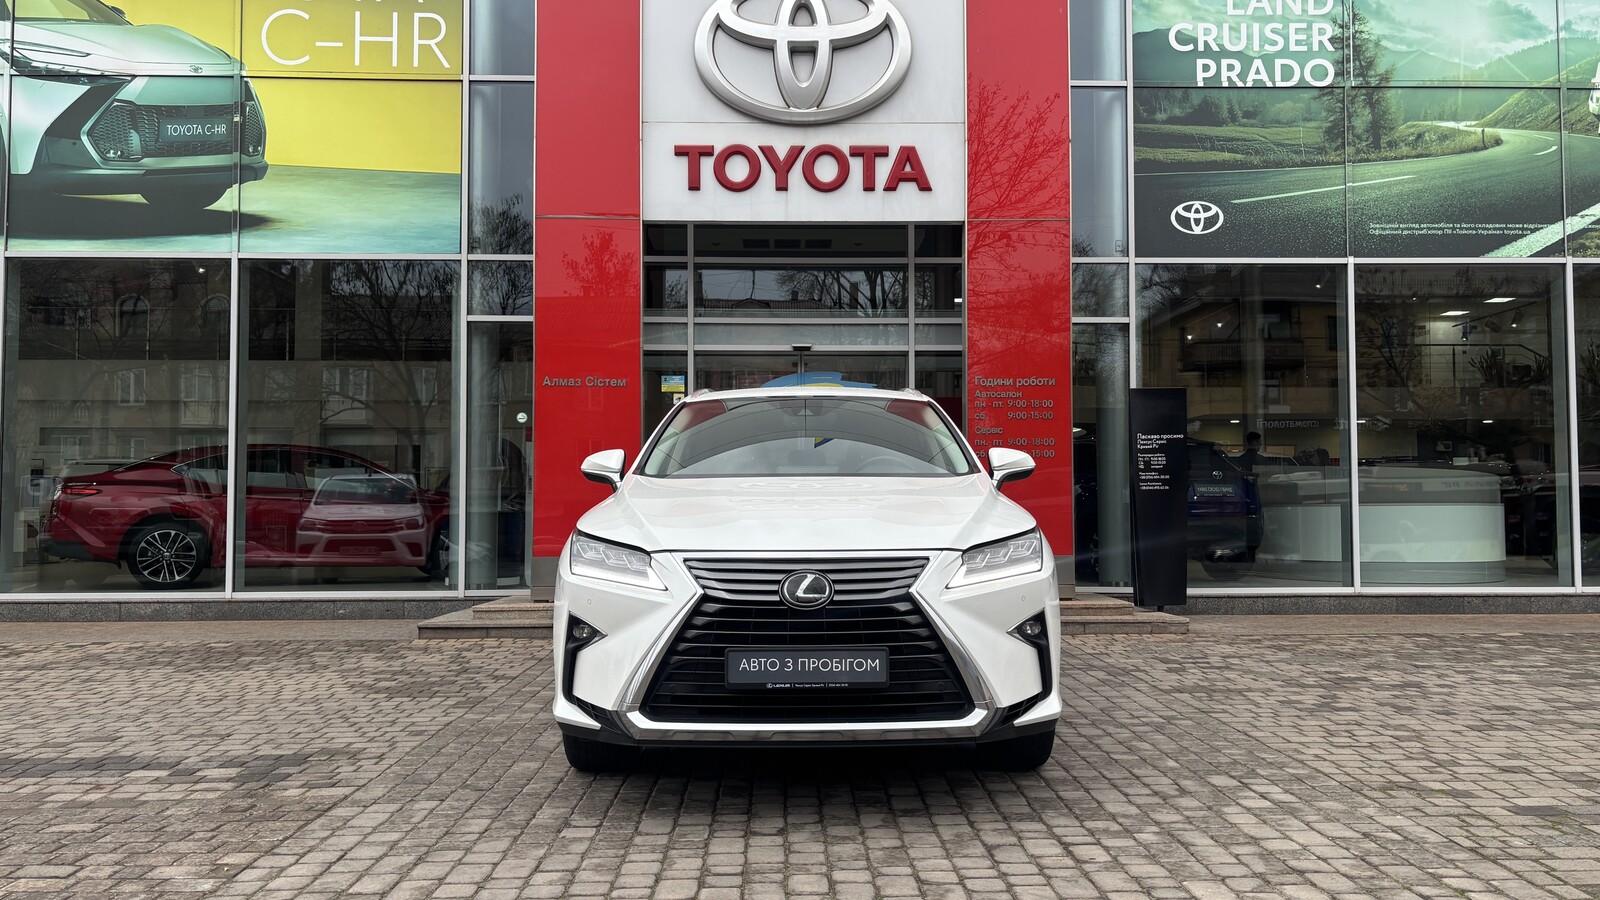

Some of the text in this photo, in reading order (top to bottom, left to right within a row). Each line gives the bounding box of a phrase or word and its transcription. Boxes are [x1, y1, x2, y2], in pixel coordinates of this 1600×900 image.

[261, 8, 451, 68] C-HR
[1168, 22, 1336, 52] CRUISER
[1196, 58, 1335, 87] PRADO
[166, 123, 227, 136] TOYOTA C-HR
[673, 143, 933, 193] TOYOTA
[542, 376, 627, 387] Алмаз Сістем
[974, 376, 1056, 388] Години роботи
[974, 390, 1022, 398] Автосалон
[974, 426, 1003, 435] Сервіс
[739, 658, 780, 671] АВТО
[798, 658, 880, 672] ПРОБІГОМ
